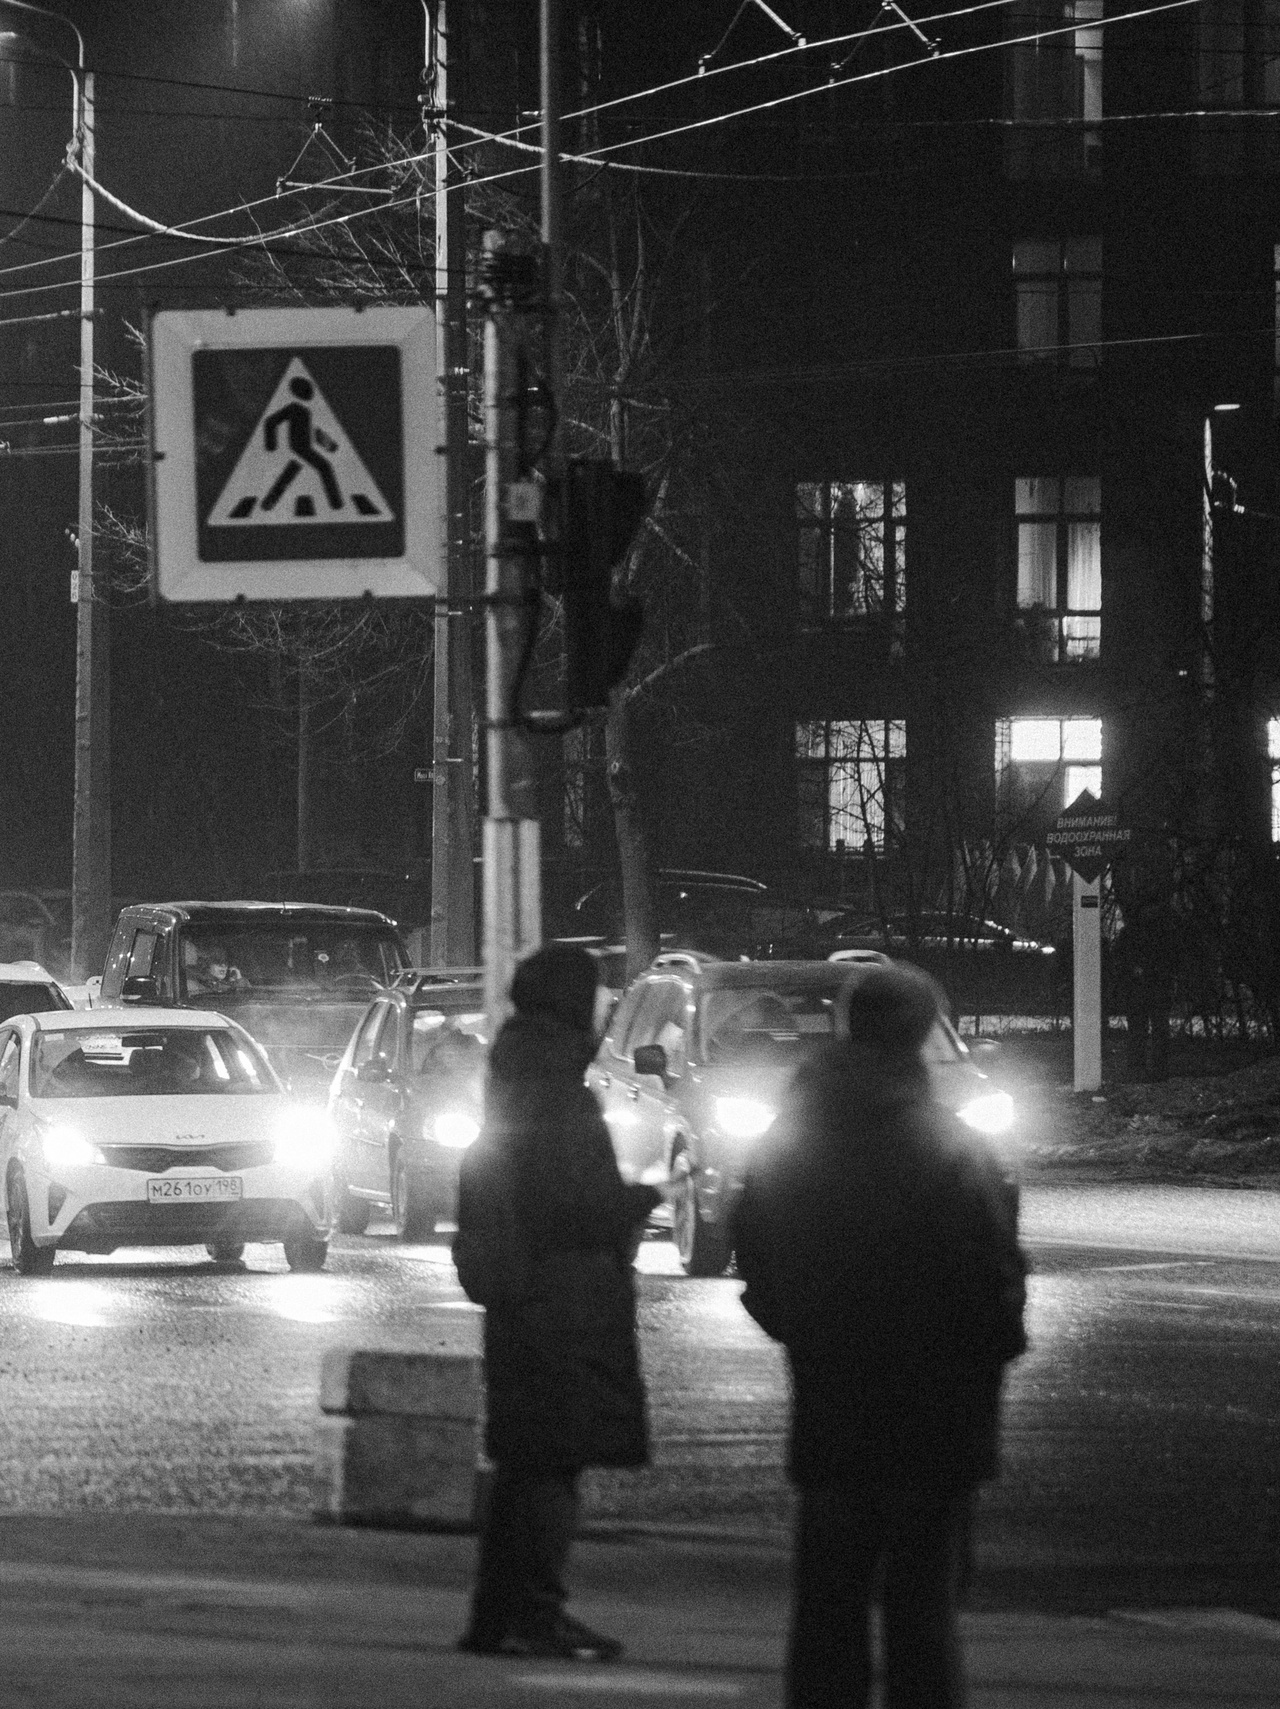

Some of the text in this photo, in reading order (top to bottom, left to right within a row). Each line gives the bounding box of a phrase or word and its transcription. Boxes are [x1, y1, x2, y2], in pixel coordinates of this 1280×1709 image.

[1056, 815, 1118, 829] ВНИМАНИЕ!
[1045, 829, 1132, 845] ВОДООХРАННАЯ
[1073, 845, 1102, 857] ЗОНА
